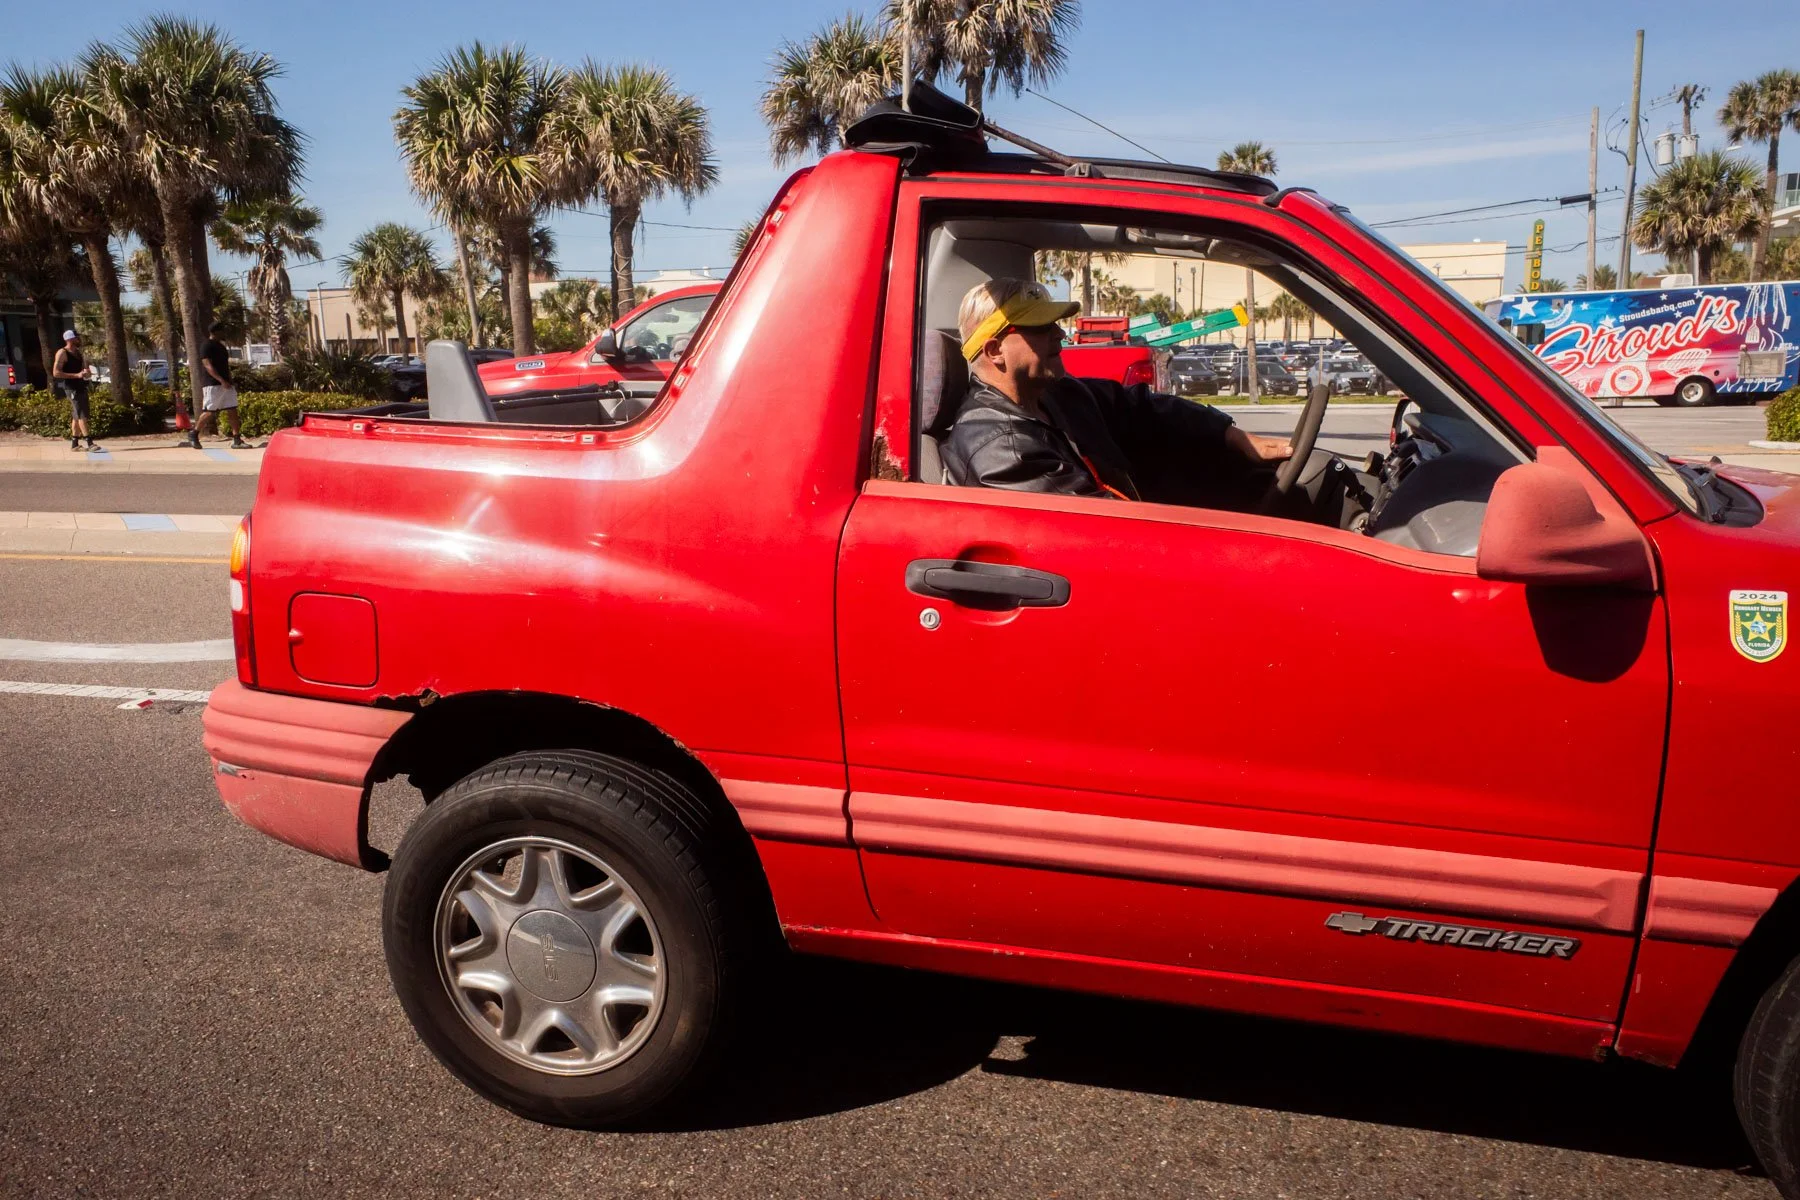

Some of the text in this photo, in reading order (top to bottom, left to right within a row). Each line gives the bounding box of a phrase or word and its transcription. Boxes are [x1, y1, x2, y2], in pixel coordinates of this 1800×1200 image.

[1618, 299, 1696, 323] Stroudsbarbq.com
[1533, 294, 1741, 380] Stroud's
[1386, 919, 1574, 957] TRACKER
